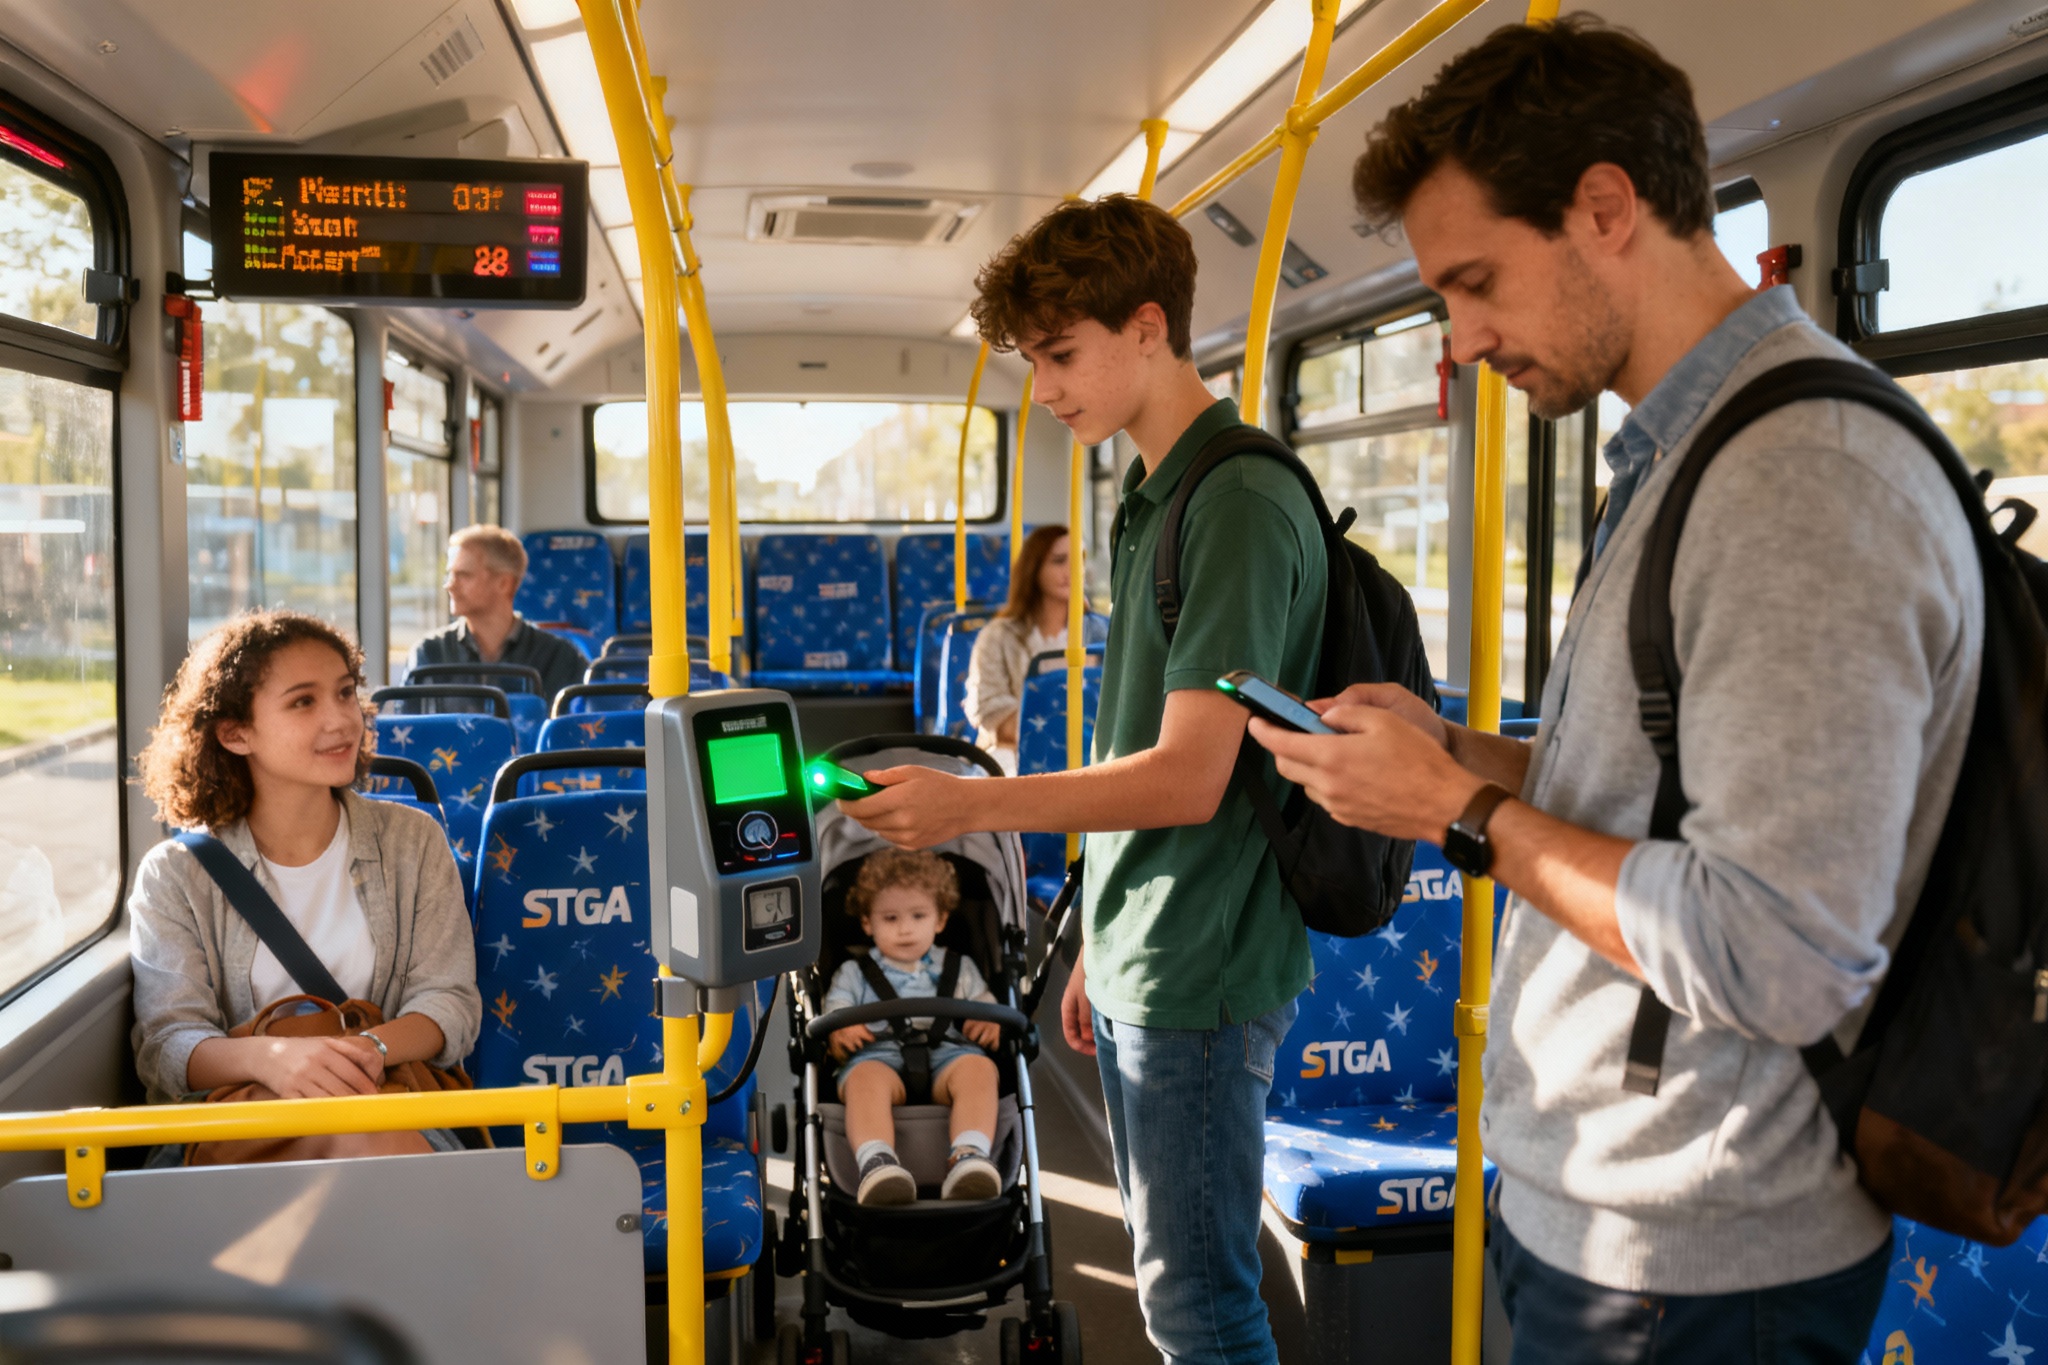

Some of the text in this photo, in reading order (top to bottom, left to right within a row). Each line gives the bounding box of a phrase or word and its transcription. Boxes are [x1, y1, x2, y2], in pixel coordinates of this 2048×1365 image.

[522, 885, 632, 929] STGA
[519, 1053, 624, 1088] STGA
[1300, 1038, 1391, 1079] STGA
